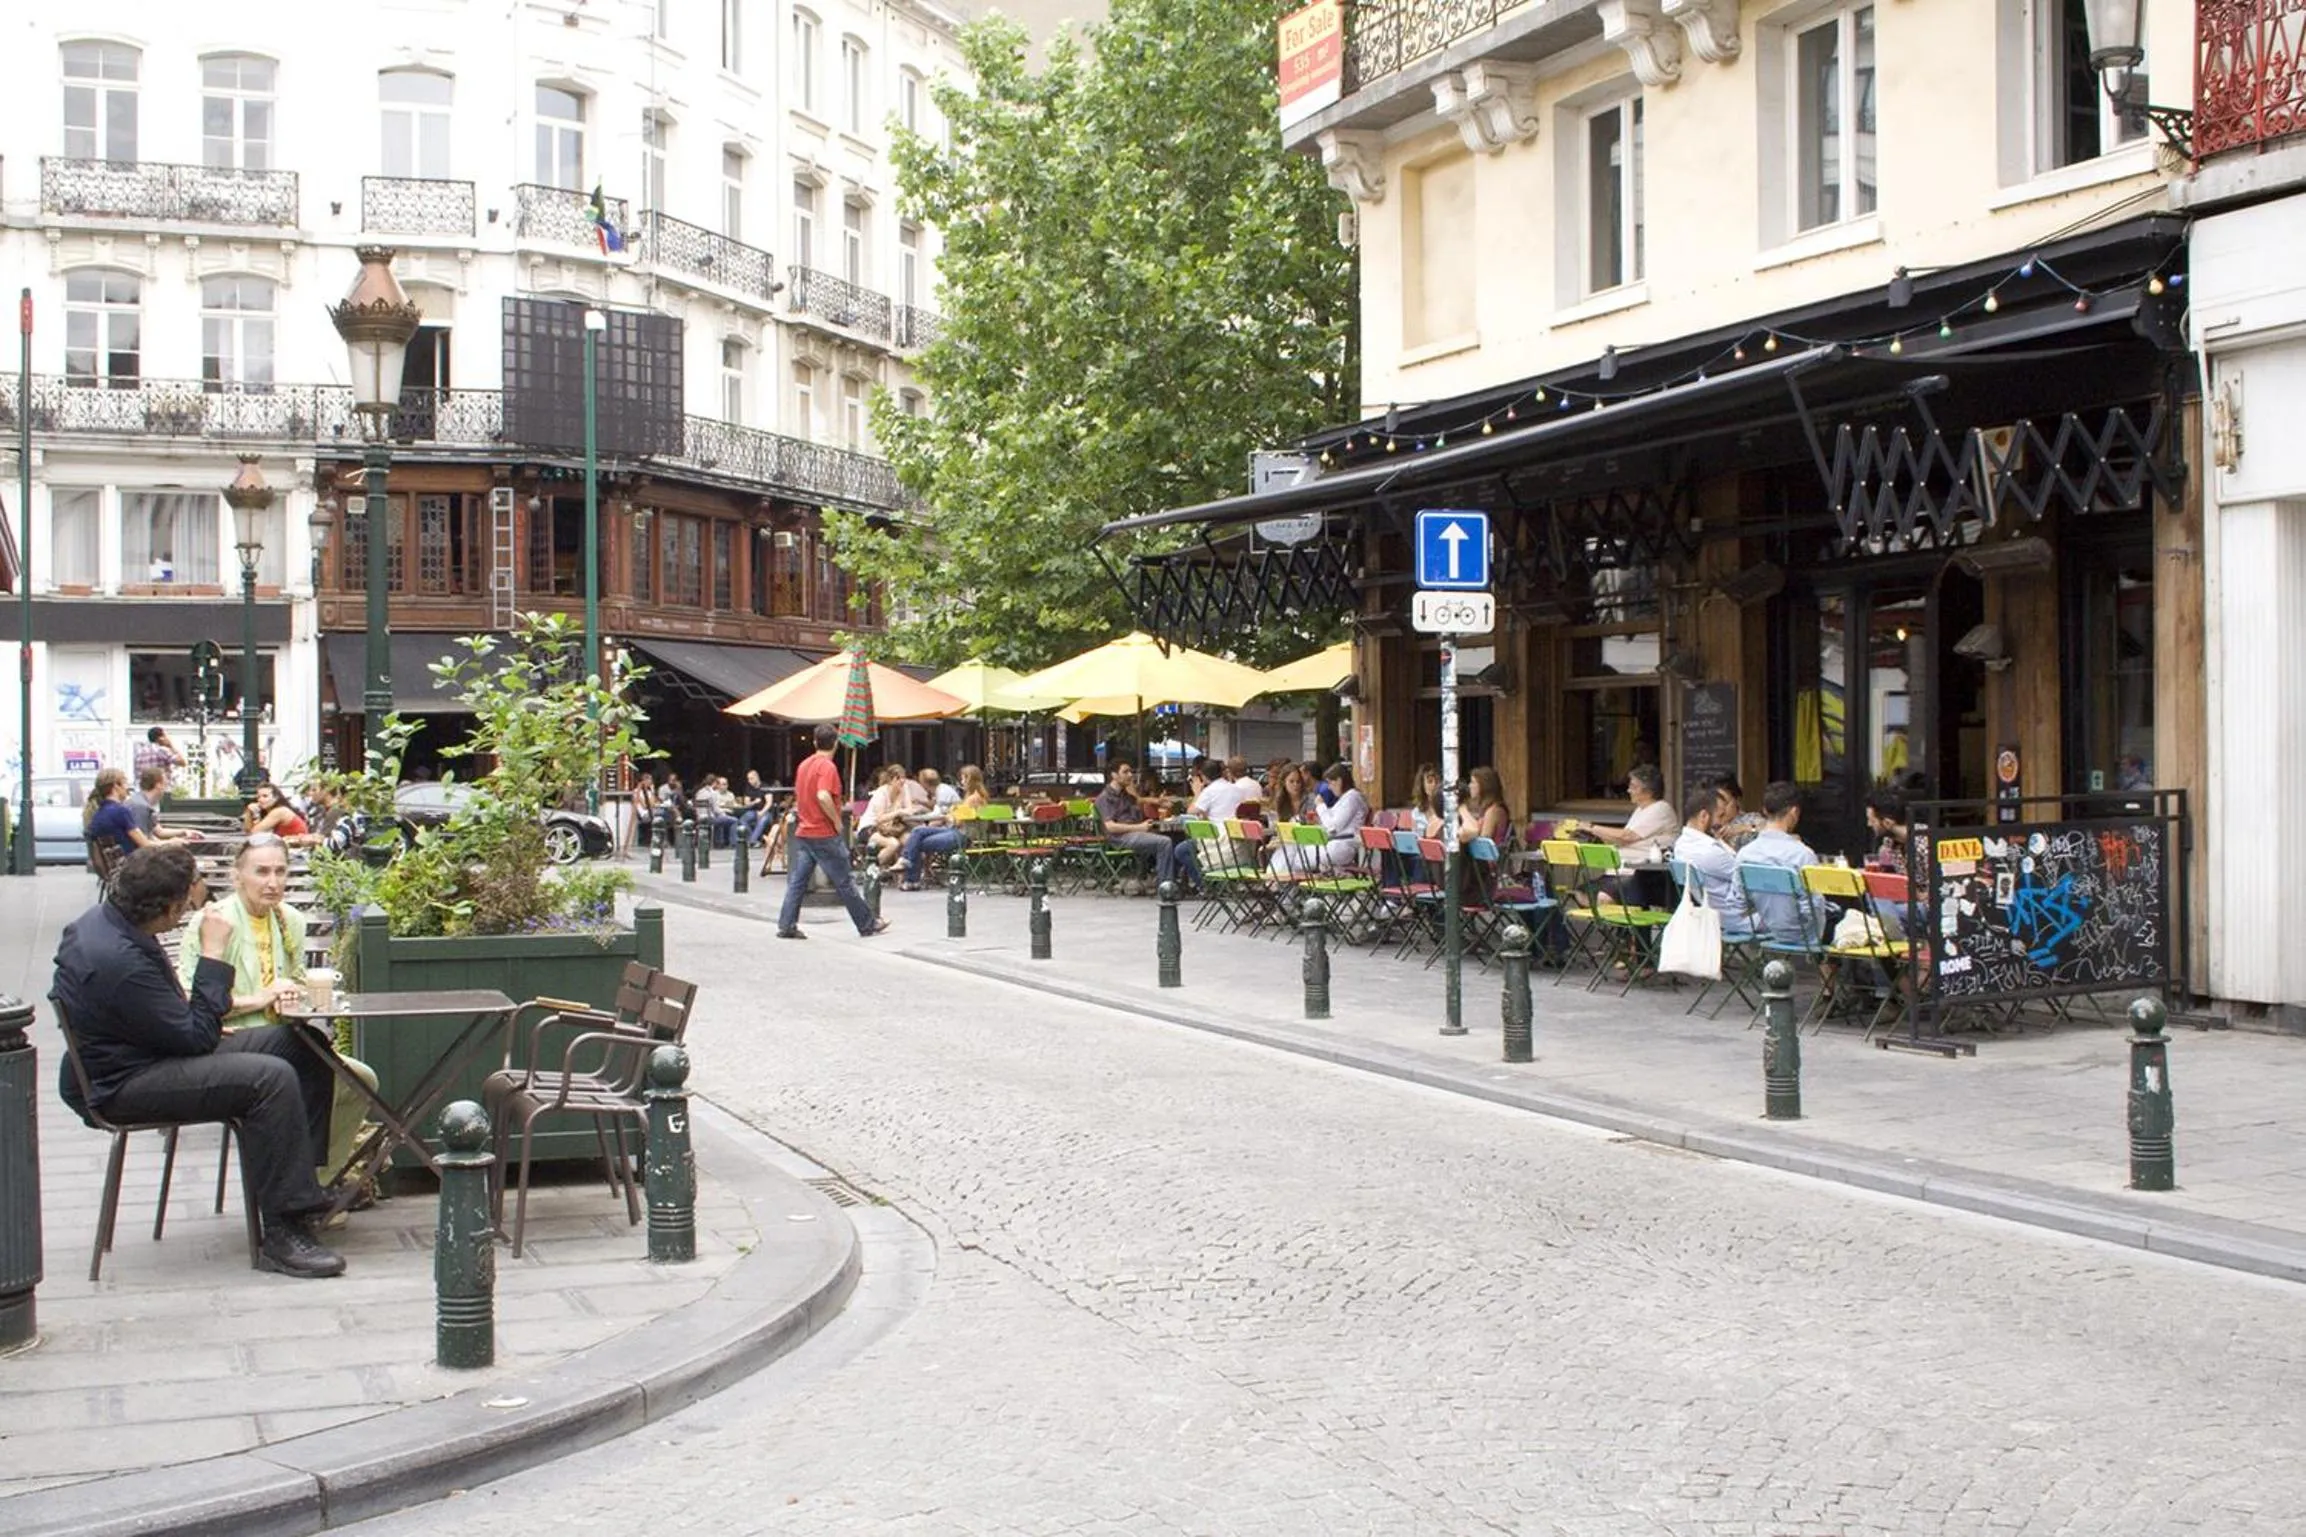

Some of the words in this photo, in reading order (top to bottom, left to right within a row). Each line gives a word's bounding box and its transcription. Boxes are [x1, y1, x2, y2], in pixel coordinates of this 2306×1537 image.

[1286, 27, 1304, 51] For
[1309, 8, 1335, 39] Sale
[1939, 956, 1972, 975] ROME
